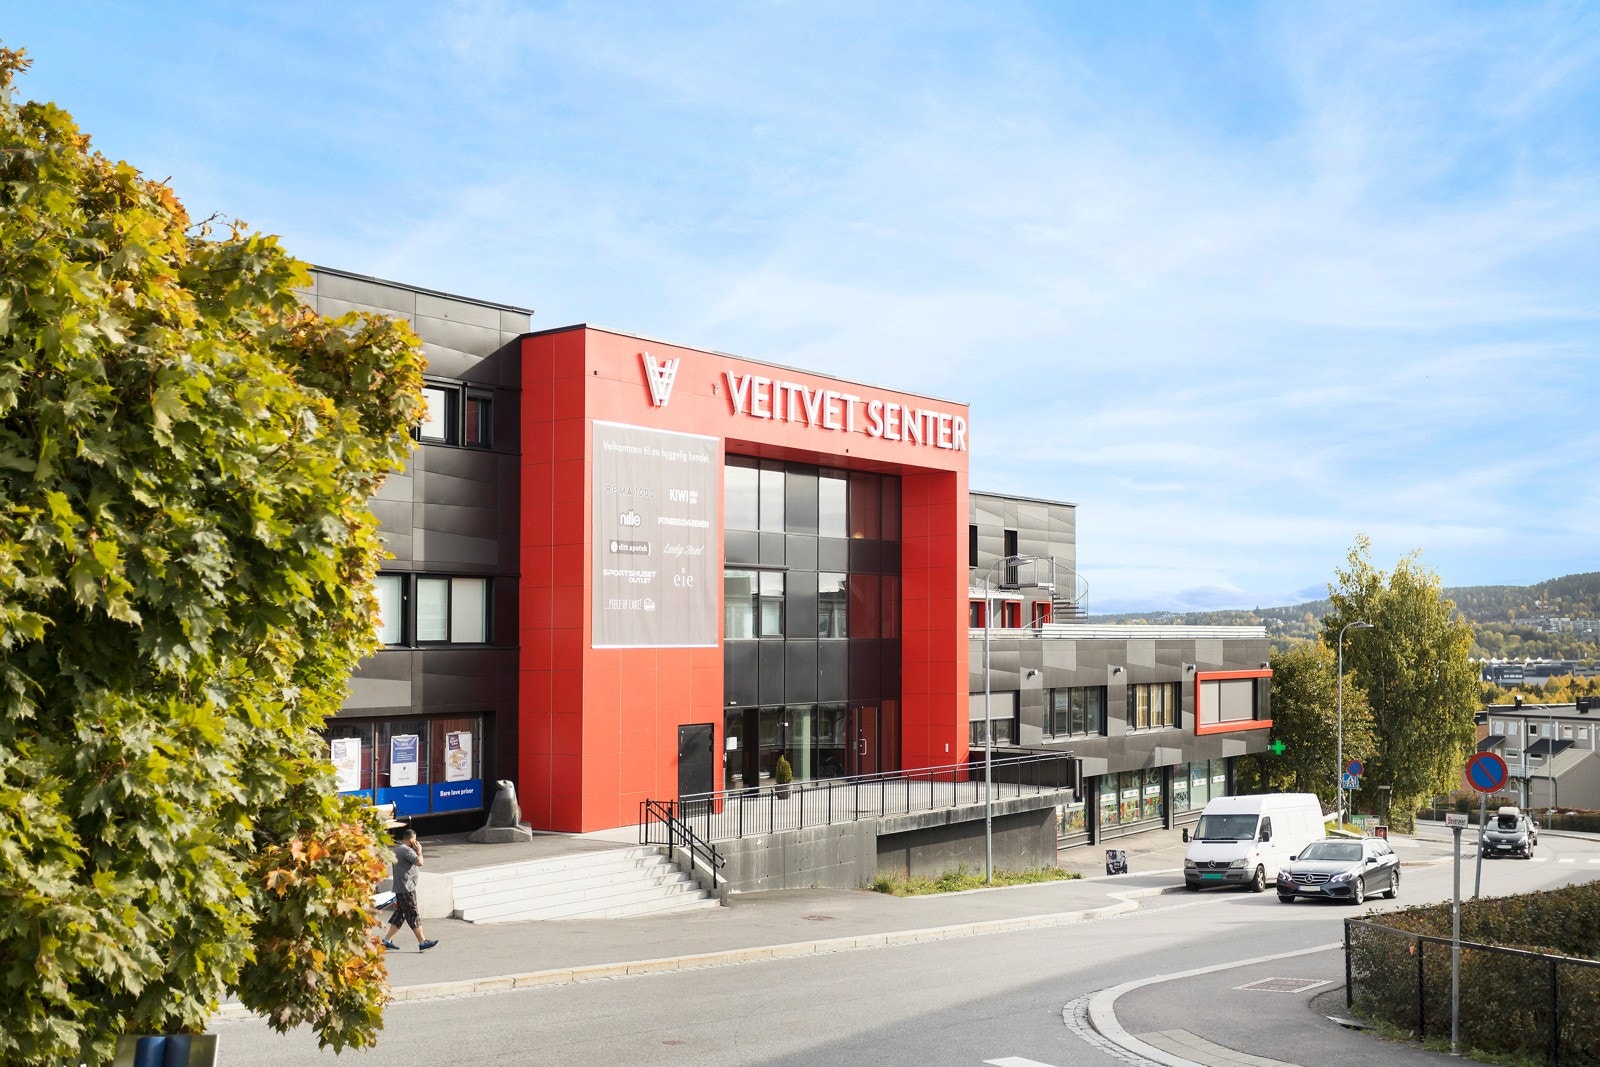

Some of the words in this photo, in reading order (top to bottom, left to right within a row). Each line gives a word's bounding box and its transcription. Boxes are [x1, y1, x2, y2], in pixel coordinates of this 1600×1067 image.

[725, 370, 860, 432] VEITVET
[866, 399, 967, 452] SENTER
[603, 441, 642, 454] Velkommen
[643, 446, 651, 456] til
[661, 448, 688, 462] hyggelig
[689, 452, 709, 462] handel
[605, 484, 633, 497] REMA
[635, 487, 655, 499] 1000
[669, 488, 689, 503] KIWI
[619, 510, 641, 528] nille
[673, 567, 694, 588] eie
